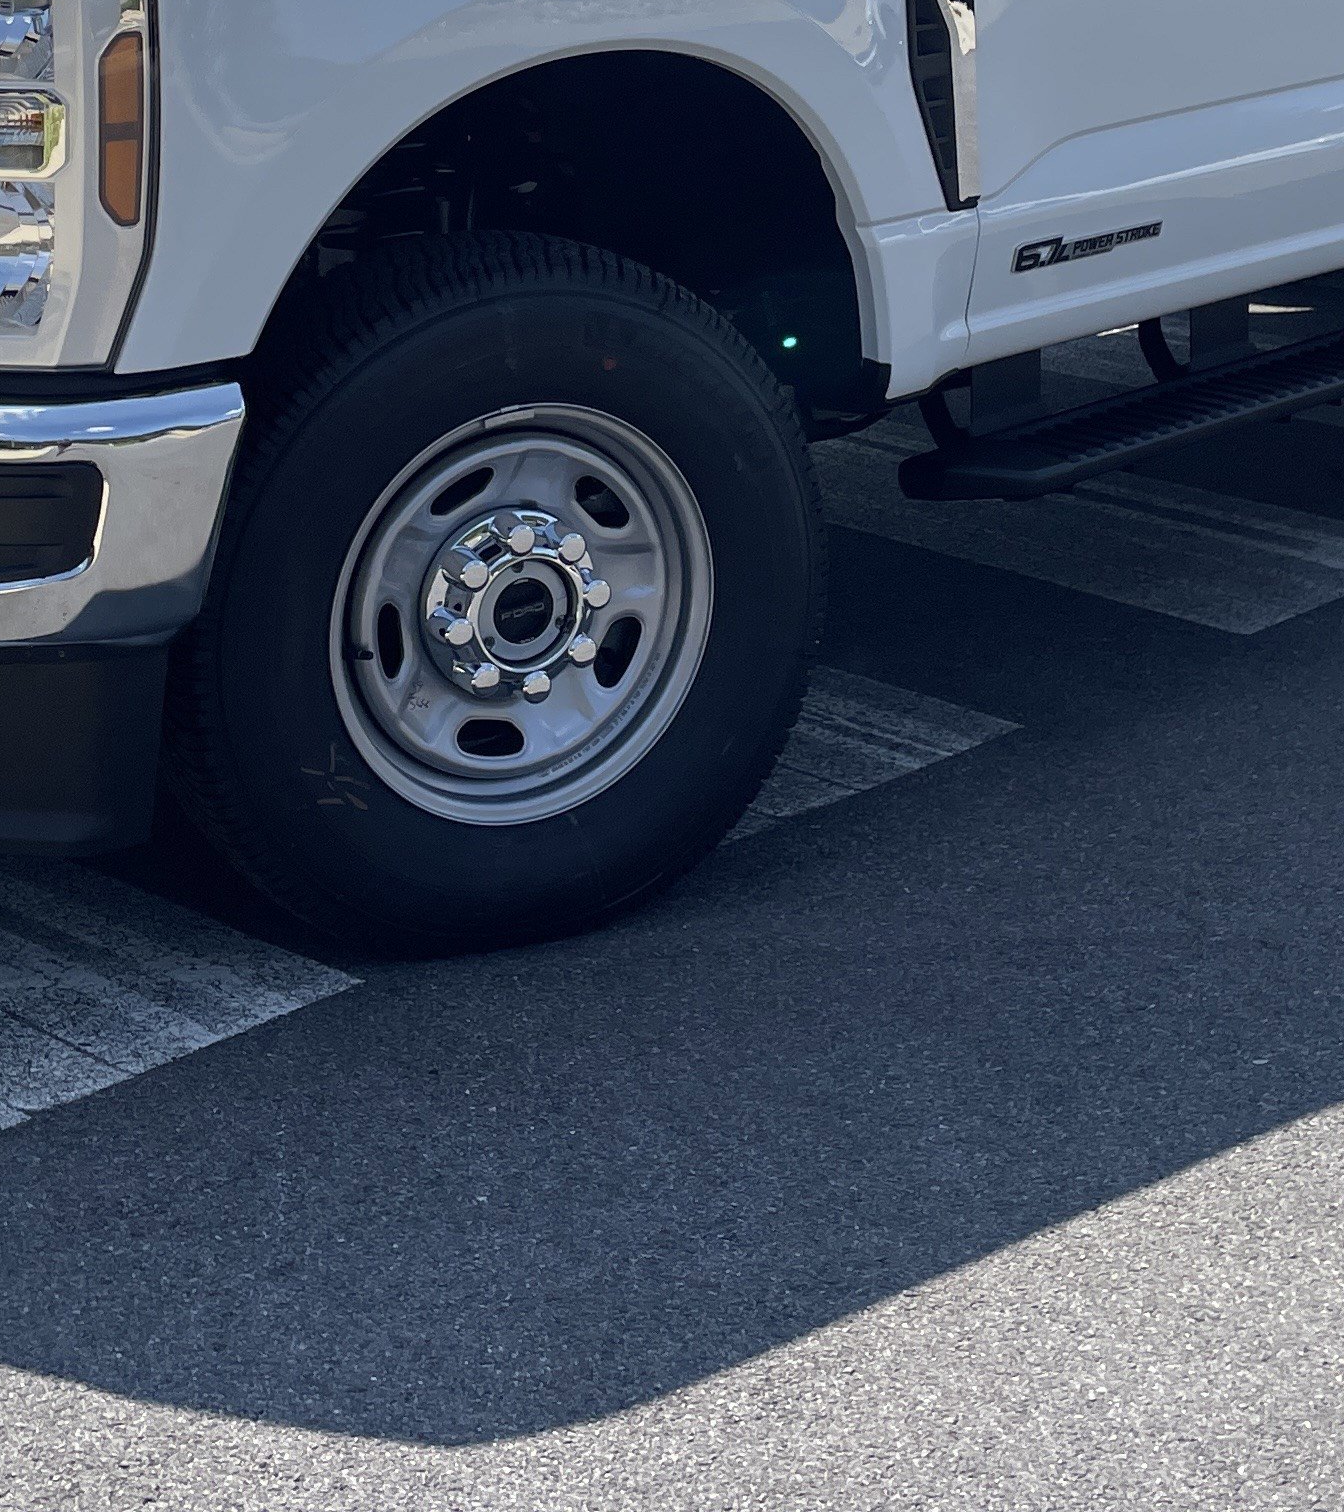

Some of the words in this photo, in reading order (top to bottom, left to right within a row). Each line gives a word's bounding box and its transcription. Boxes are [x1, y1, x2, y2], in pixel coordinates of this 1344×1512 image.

[1072, 233, 1114, 256] POWER
[1115, 223, 1162, 245] STROKE
[500, 601, 546, 622] FORD
